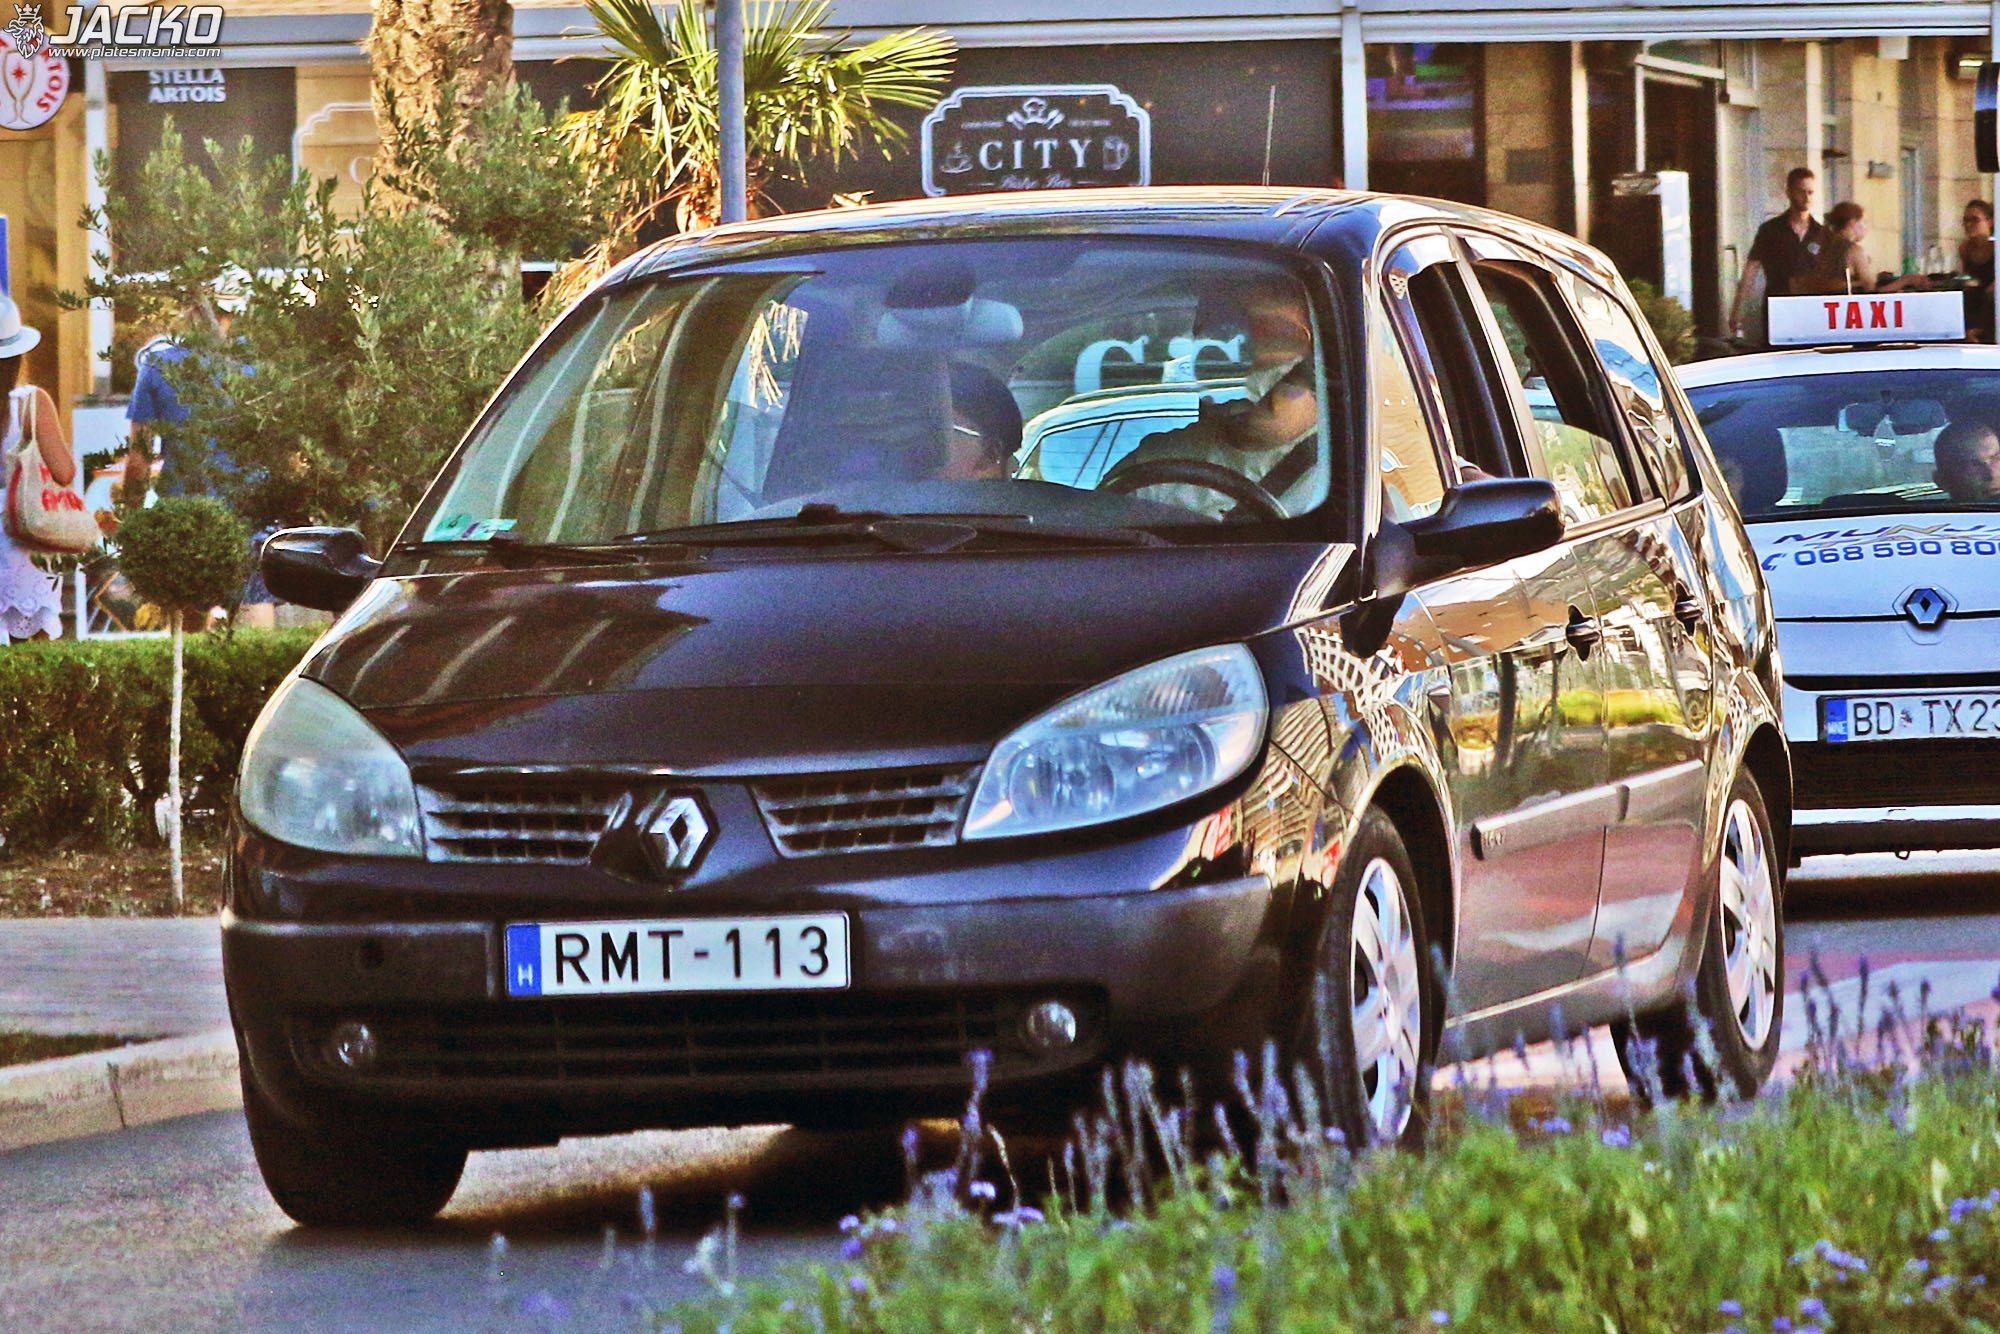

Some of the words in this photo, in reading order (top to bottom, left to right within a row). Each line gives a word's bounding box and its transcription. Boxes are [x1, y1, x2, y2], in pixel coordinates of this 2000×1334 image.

[149, 69, 225, 84] STELLA
[149, 86, 227, 104] ARTOIS
[978, 138, 1092, 171] CITY
[1824, 300, 1903, 330] TAXI
[1794, 546, 1864, 567] 068
[1873, 541, 1941, 558] 590
[1951, 541, 2000, 555] 80
[1853, 702, 1895, 736] BD
[554, 925, 830, 985] RMT-113
